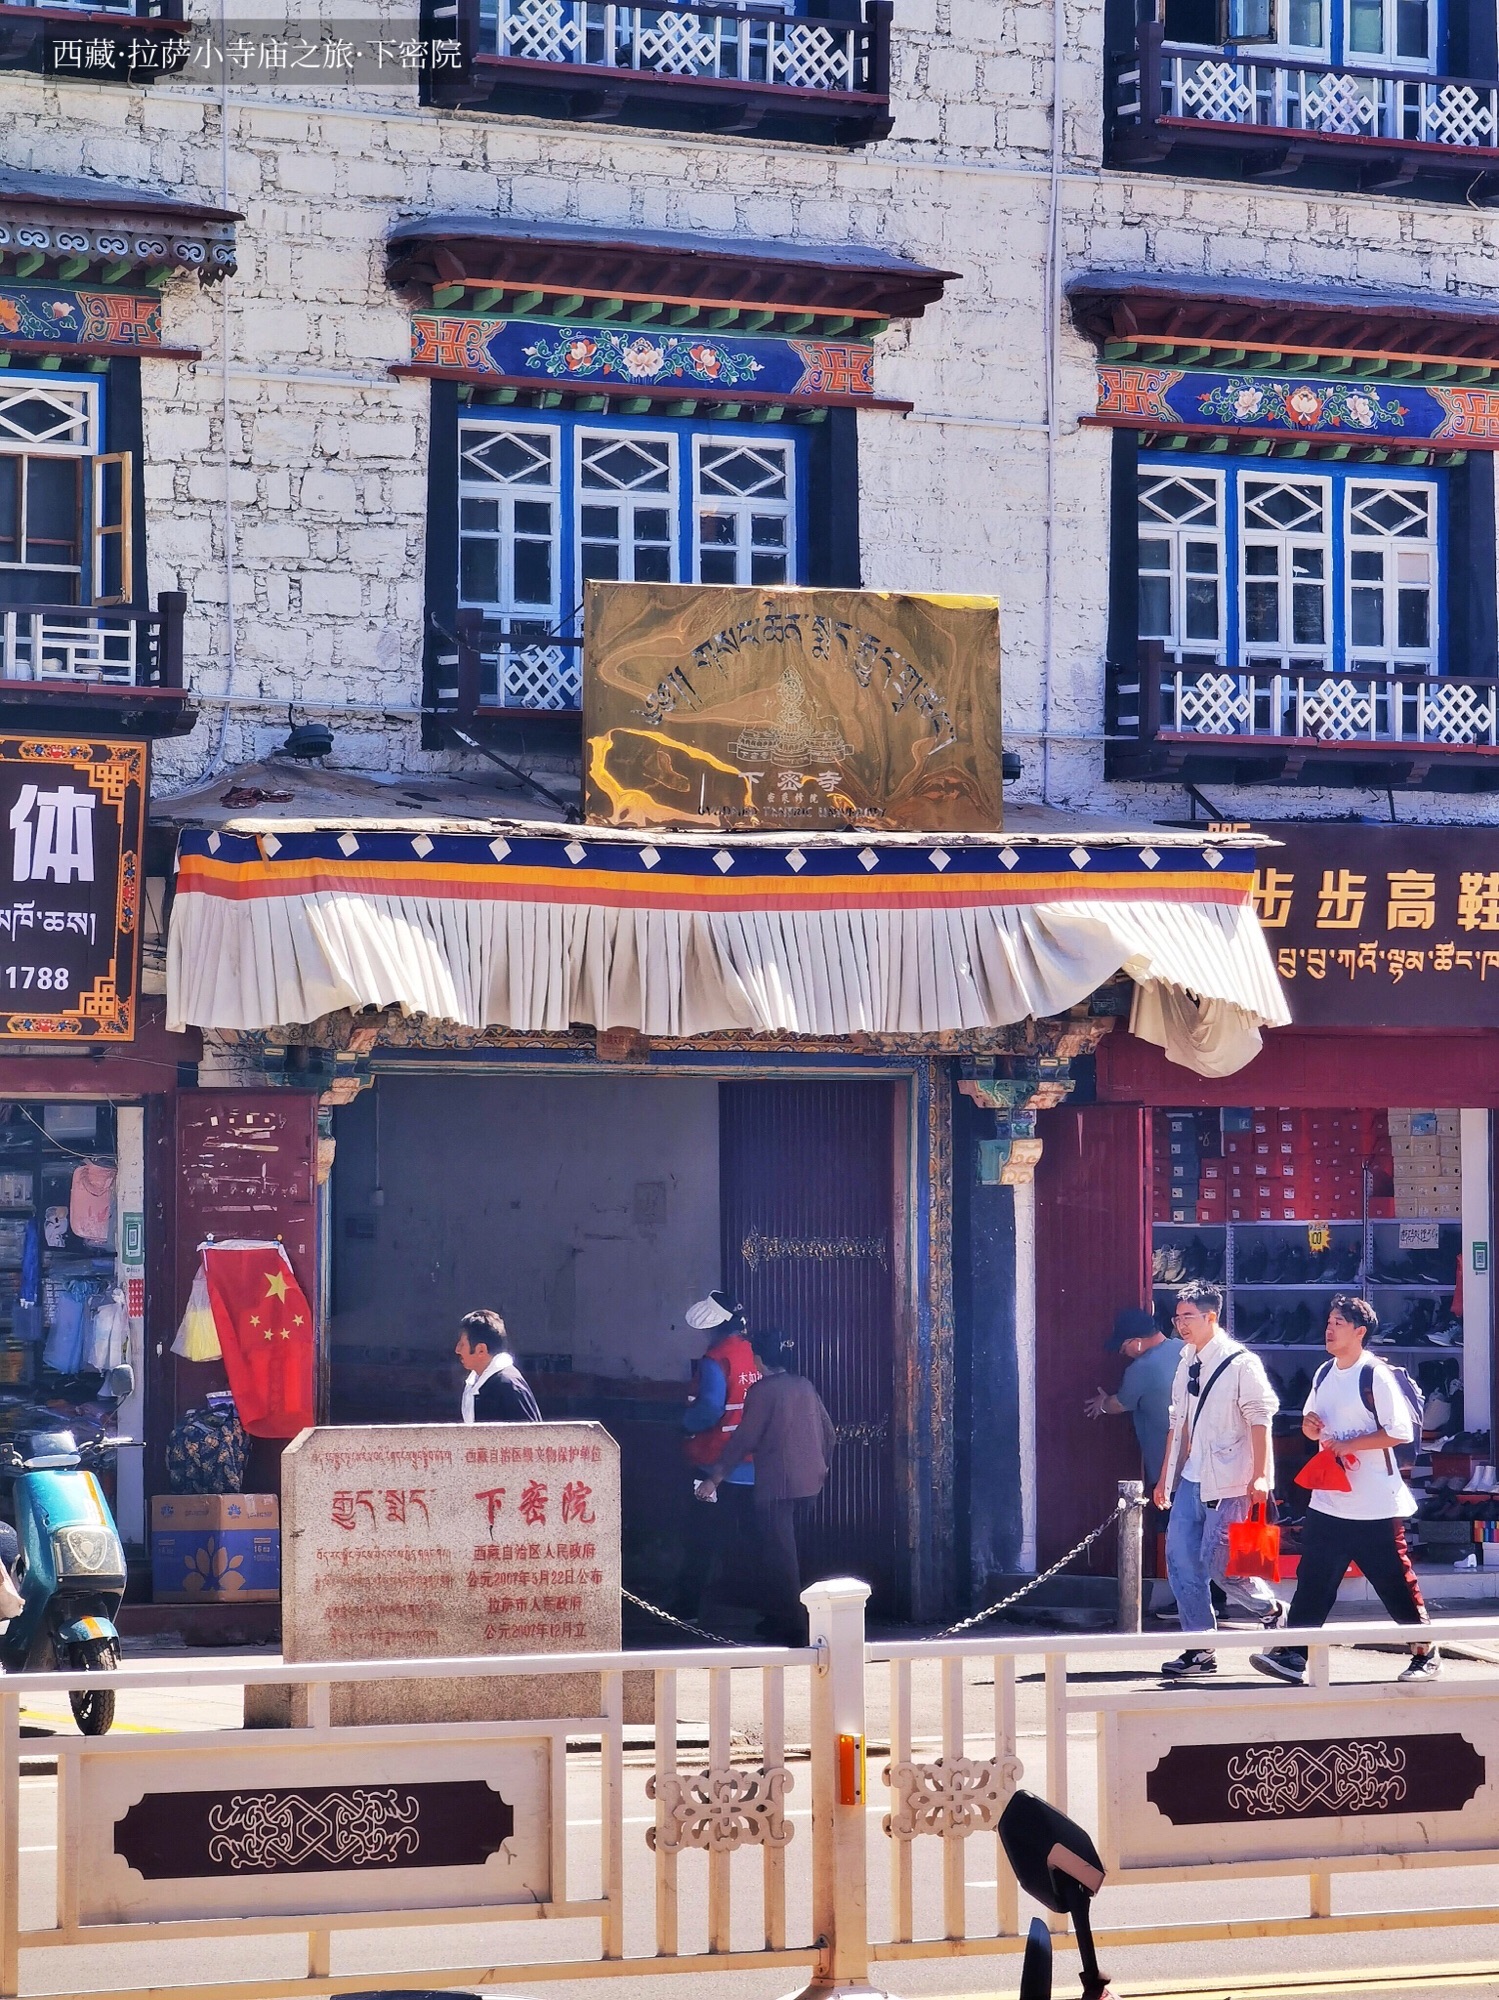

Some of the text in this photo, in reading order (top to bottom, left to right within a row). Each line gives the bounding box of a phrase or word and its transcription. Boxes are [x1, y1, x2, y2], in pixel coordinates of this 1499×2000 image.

[738, 770, 843, 792] 下密寺
[10, 784, 96, 883] 体
[1254, 868, 1499, 931] 步步高鞋
[5, 966, 69, 990] 1788
[475, 1480, 596, 1526] 下密院
[474, 1543, 596, 1560] 西藏自治区人民政府
[488, 1596, 582, 1614] 拉萨市人民政府
